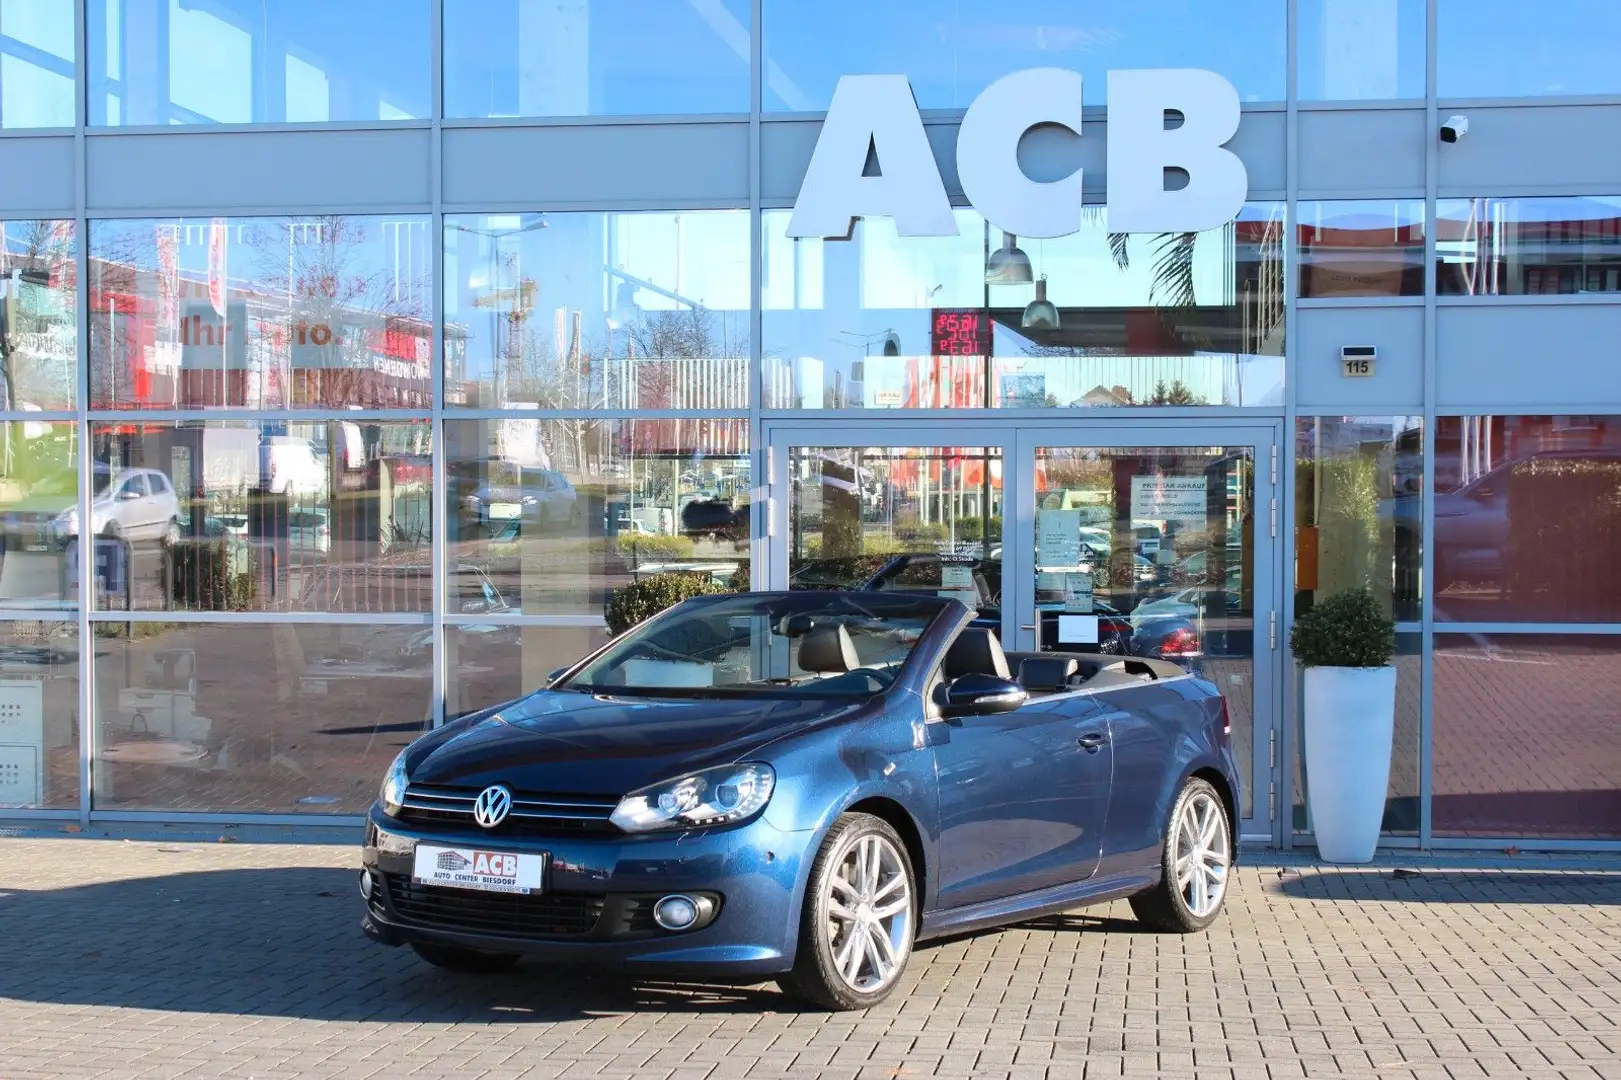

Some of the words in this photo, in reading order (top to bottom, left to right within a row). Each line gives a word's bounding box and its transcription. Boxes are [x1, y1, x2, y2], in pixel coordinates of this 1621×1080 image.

[785, 67, 1248, 239] ACB
[1346, 360, 1369, 373] 115
[474, 853, 517, 876] ACB
[433, 871, 451, 880] AUTO
[455, 873, 478, 883] CENTER
[482, 876, 517, 886] BIESDORF
